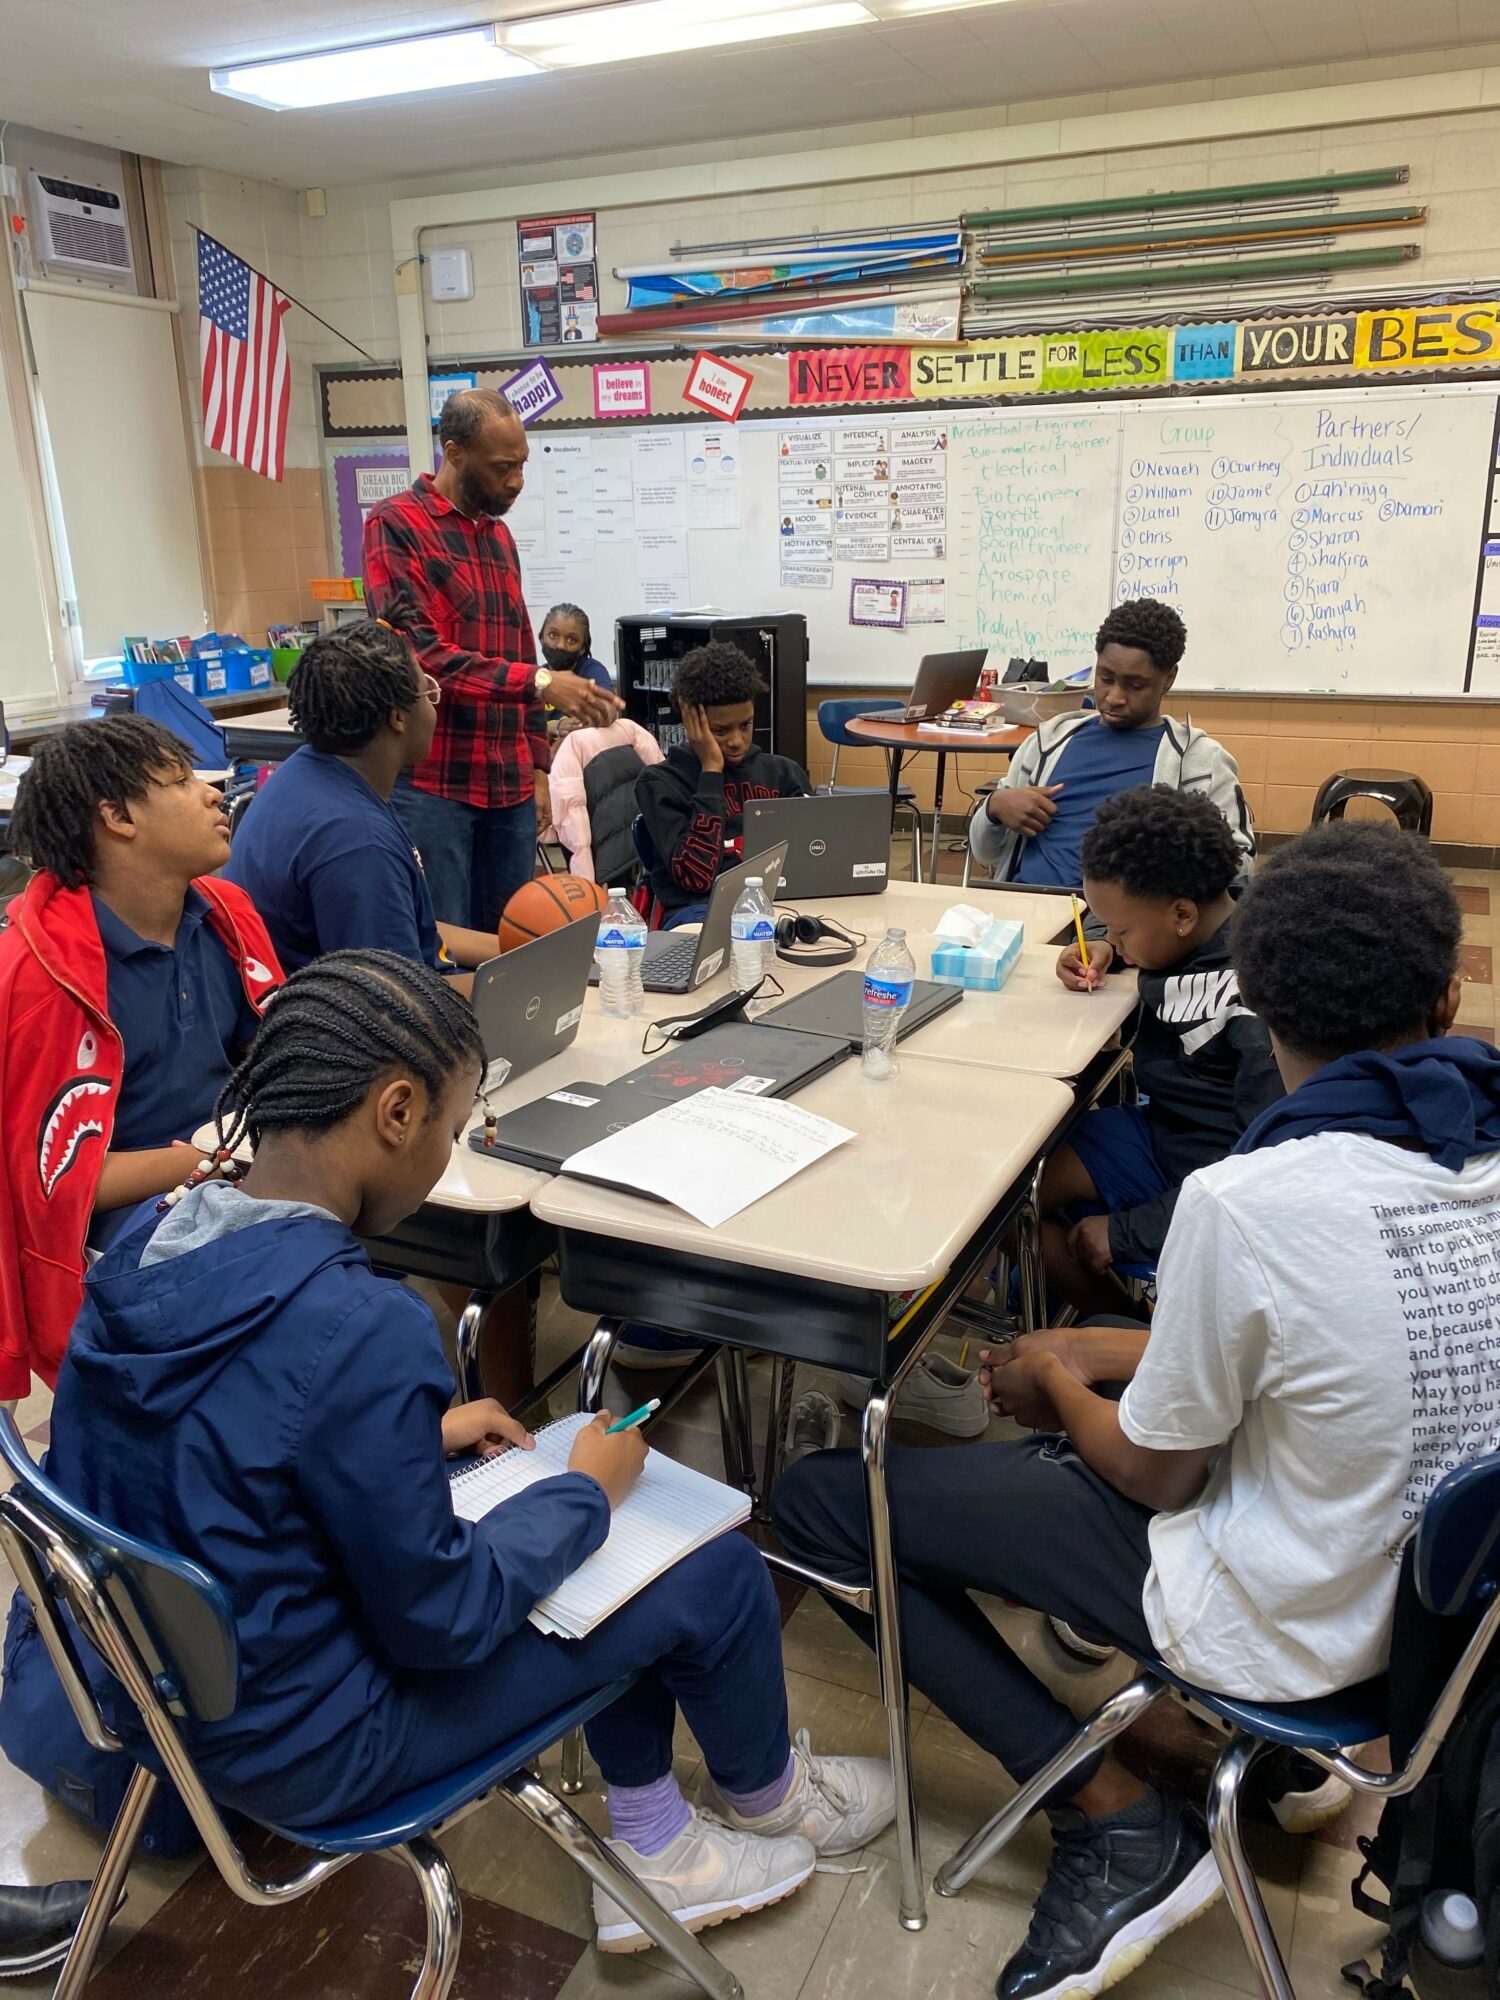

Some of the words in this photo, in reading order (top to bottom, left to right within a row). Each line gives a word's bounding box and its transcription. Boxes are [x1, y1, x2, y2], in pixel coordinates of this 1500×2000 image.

[798, 359, 901, 394] NEVER
[917, 350, 1035, 385] SETTLE
[1049, 346, 1077, 362] FOR
[1082, 343, 1162, 379] LESS
[1178, 340, 1230, 363] THAN
[1249, 323, 1349, 366] YOUR
[606, 379, 633, 389] believe
[698, 378, 732, 404] honest
[512, 379, 552, 415] happy
[614, 391, 642, 401] dreams
[1160, 416, 1215, 448] Group
[1316, 408, 1422, 441] Partners/
[788, 433, 822, 441] VISUALIZE
[844, 431, 879, 439] INFERENCE
[901, 430, 936, 439] ANALYSIS
[848, 460, 875, 468] IMPLICIT
[1302, 443, 1413, 472] Individuals
[1229, 460, 1281, 477] Courtney
[363, 474, 390, 485] DREAM
[391, 474, 405, 485] BIG
[895, 483, 942, 491] ANNOTATING
[362, 487, 384, 497] WORK
[1226, 483, 1272, 500] Jamie
[902, 508, 944, 516] CHARACTER
[1311, 508, 1363, 523] Marcus
[1395, 500, 1442, 517] Damari
[1224, 507, 1277, 532] Jamyra
[1309, 529, 1360, 550] Sharon
[977, 562, 1072, 585] Aerospace
[975, 580, 1057, 606] Chemical
[1131, 579, 1178, 598] Messiah
[1306, 579, 1340, 600] Kiara
[1046, 611, 1097, 647] Enginee
[1370, 1204, 1416, 1219] There
[1418, 1202, 1439, 1214] are
[1440, 1194, 1496, 1212] moments
[1380, 1224, 1415, 1240] miss
[1418, 1219, 1473, 1236] someone
[1473, 1215, 1487, 1226] so
[1386, 1242, 1427, 1259] want
[1428, 1241, 1444, 1254] to
[1447, 1234, 1474, 1254] pick
[1393, 1262, 1424, 1279] and
[1427, 1261, 1459, 1277] hug
[1459, 1254, 1492, 1270] them
[1492, 1247, 1500, 1261] fo
[1398, 1286, 1429, 1304] you
[1433, 1278, 1472, 1296] want
[1473, 1277, 1486, 1289] to
[1402, 1304, 1444, 1320] want
[1447, 1302, 1464, 1315] to
[1409, 1344, 1440, 1360] and
[1444, 1342, 1474, 1357] one
[1478, 1336, 1500, 1351] cha
[1410, 1368, 1442, 1385] you
[1446, 1360, 1486, 1377] want
[1411, 1385, 1447, 1400] May
[1451, 1383, 1482, 1400] you
[1486, 1378, 1500, 1392] ha
[1412, 1403, 1459, 1418] make
[1463, 1401, 1494, 1417] you
[1412, 1421, 1457, 1437] make
[1461, 1421, 1492, 1436] you
[1413, 1441, 1452, 1454] keep
[1456, 1438, 1485, 1455] you
[1410, 1456, 1455, 1471] make
[1407, 1473, 1437, 1488] self
[1405, 1489, 1418, 1503] it
